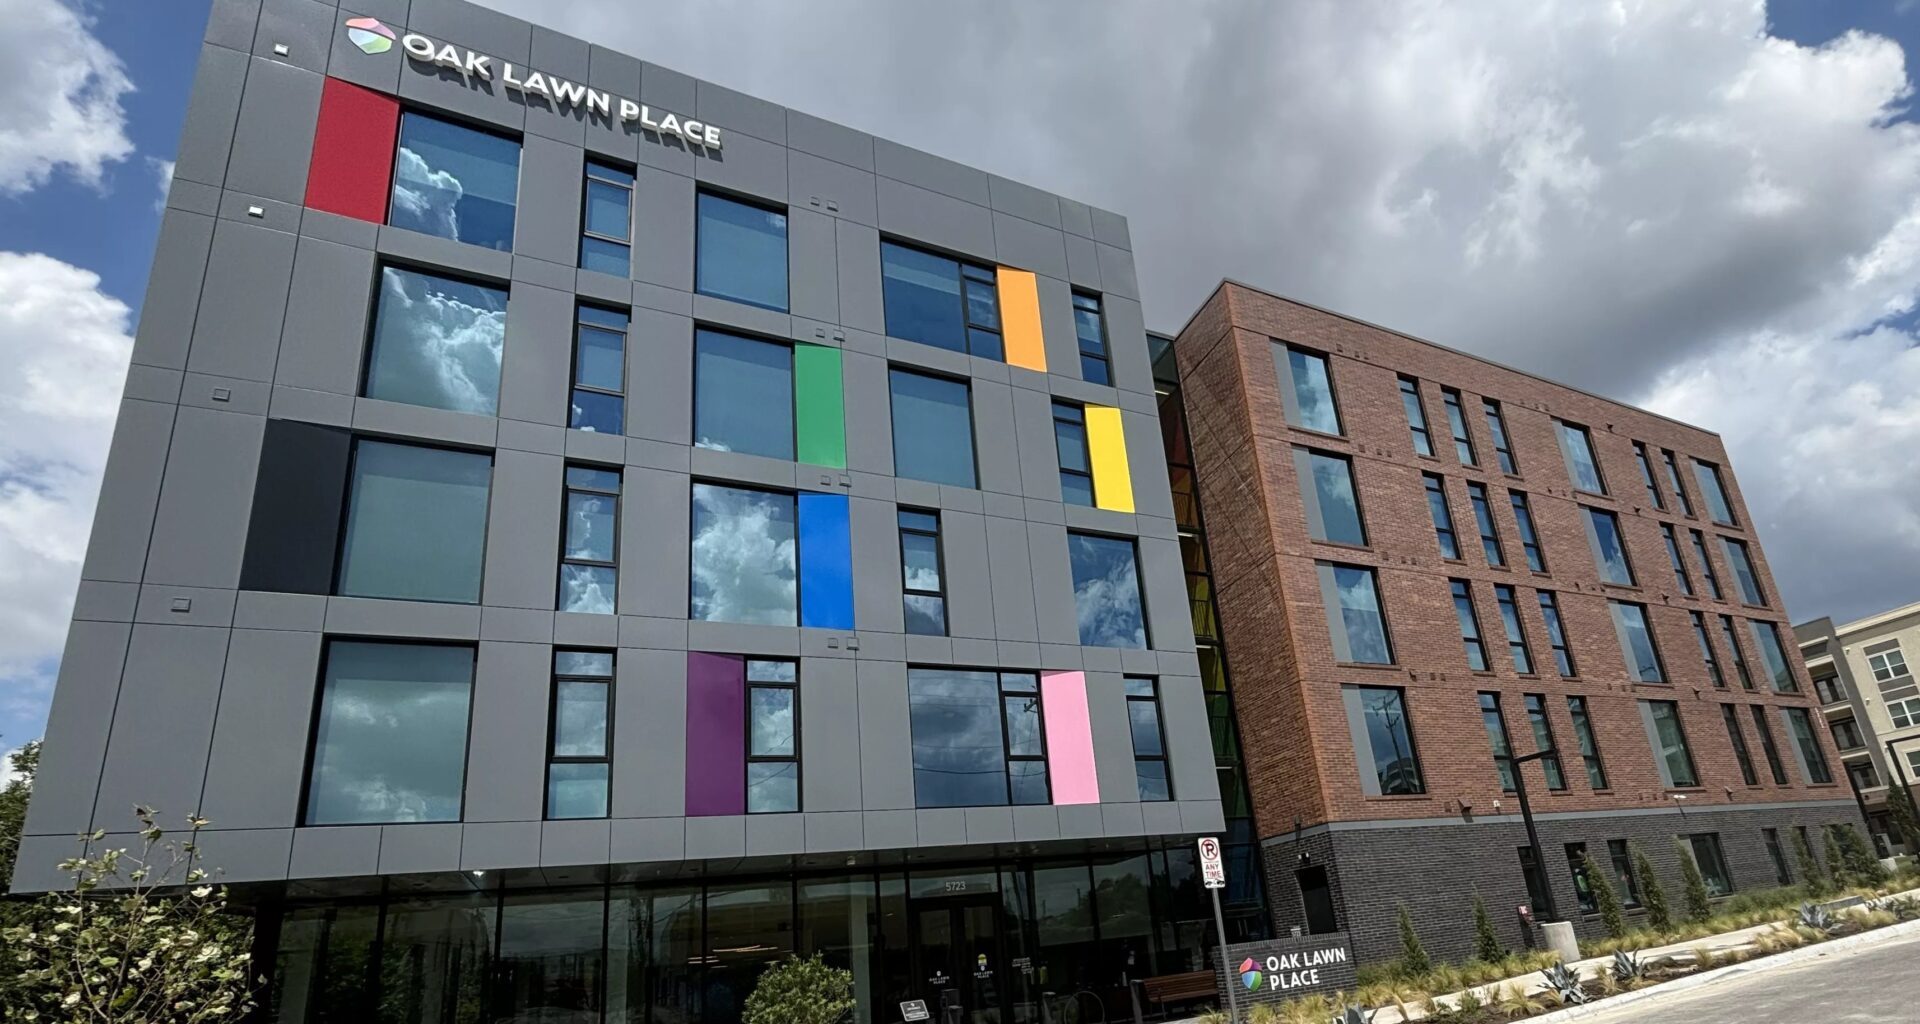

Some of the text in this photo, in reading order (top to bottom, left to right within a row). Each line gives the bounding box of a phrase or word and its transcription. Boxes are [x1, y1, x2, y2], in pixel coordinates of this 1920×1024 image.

[402, 33, 722, 150] OAK LAWN PLACE
[1205, 870, 1222, 878] TIME
[945, 881, 966, 892] 5723
[1266, 947, 1346, 971] OAK LAWN
[1270, 969, 1320, 991] PLACE
